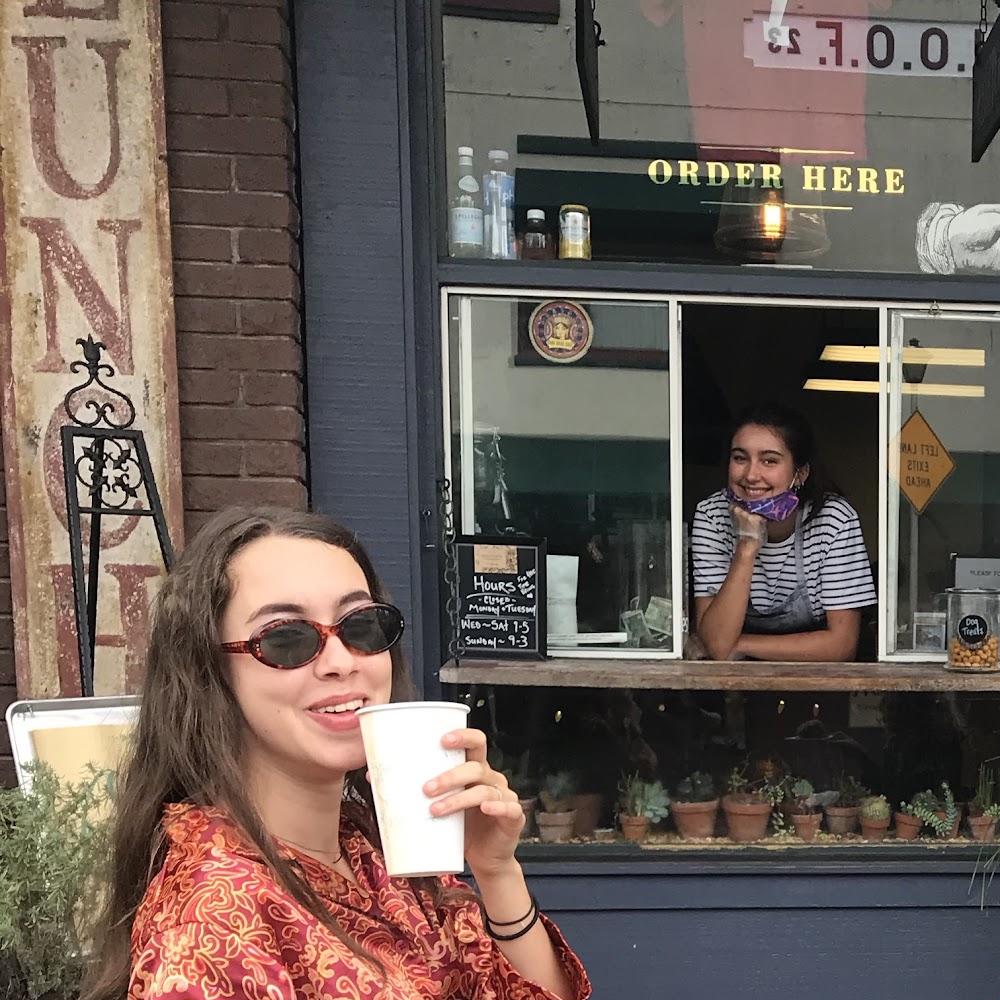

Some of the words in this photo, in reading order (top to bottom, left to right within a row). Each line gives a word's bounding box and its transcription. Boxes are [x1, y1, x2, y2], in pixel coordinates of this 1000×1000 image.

[648, 159, 783, 189] ORDER
[801, 164, 905, 195] HERE
[11, 0, 161, 697] UNCH
[965, 618, 980, 630] Dog
[508, 634, 529, 648] 9-3
